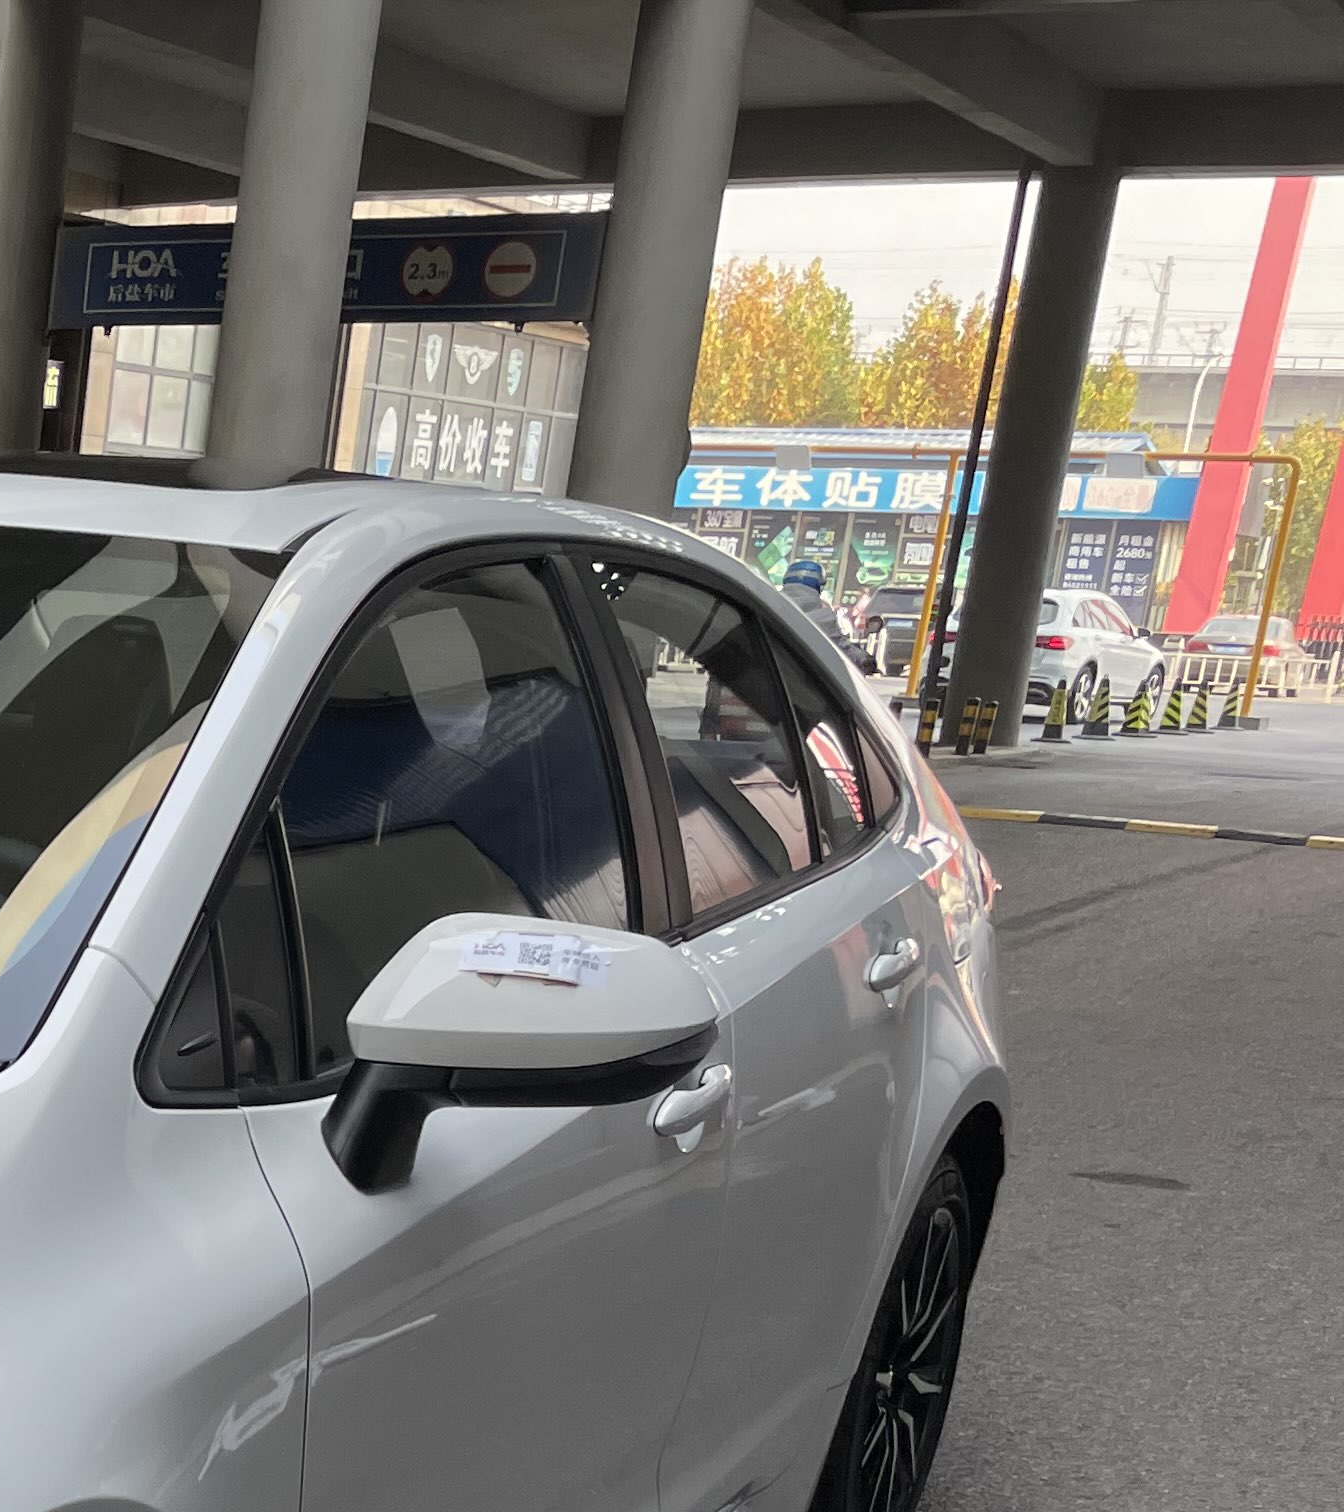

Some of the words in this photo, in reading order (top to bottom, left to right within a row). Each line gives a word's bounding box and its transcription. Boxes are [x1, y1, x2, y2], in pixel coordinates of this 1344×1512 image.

[110, 248, 177, 279] HOA
[407, 262, 449, 281] 2.3m
[410, 409, 514, 478] 高价收车
[689, 467, 947, 510] 车体贴膜
[1118, 535, 1154, 547] 月租金
